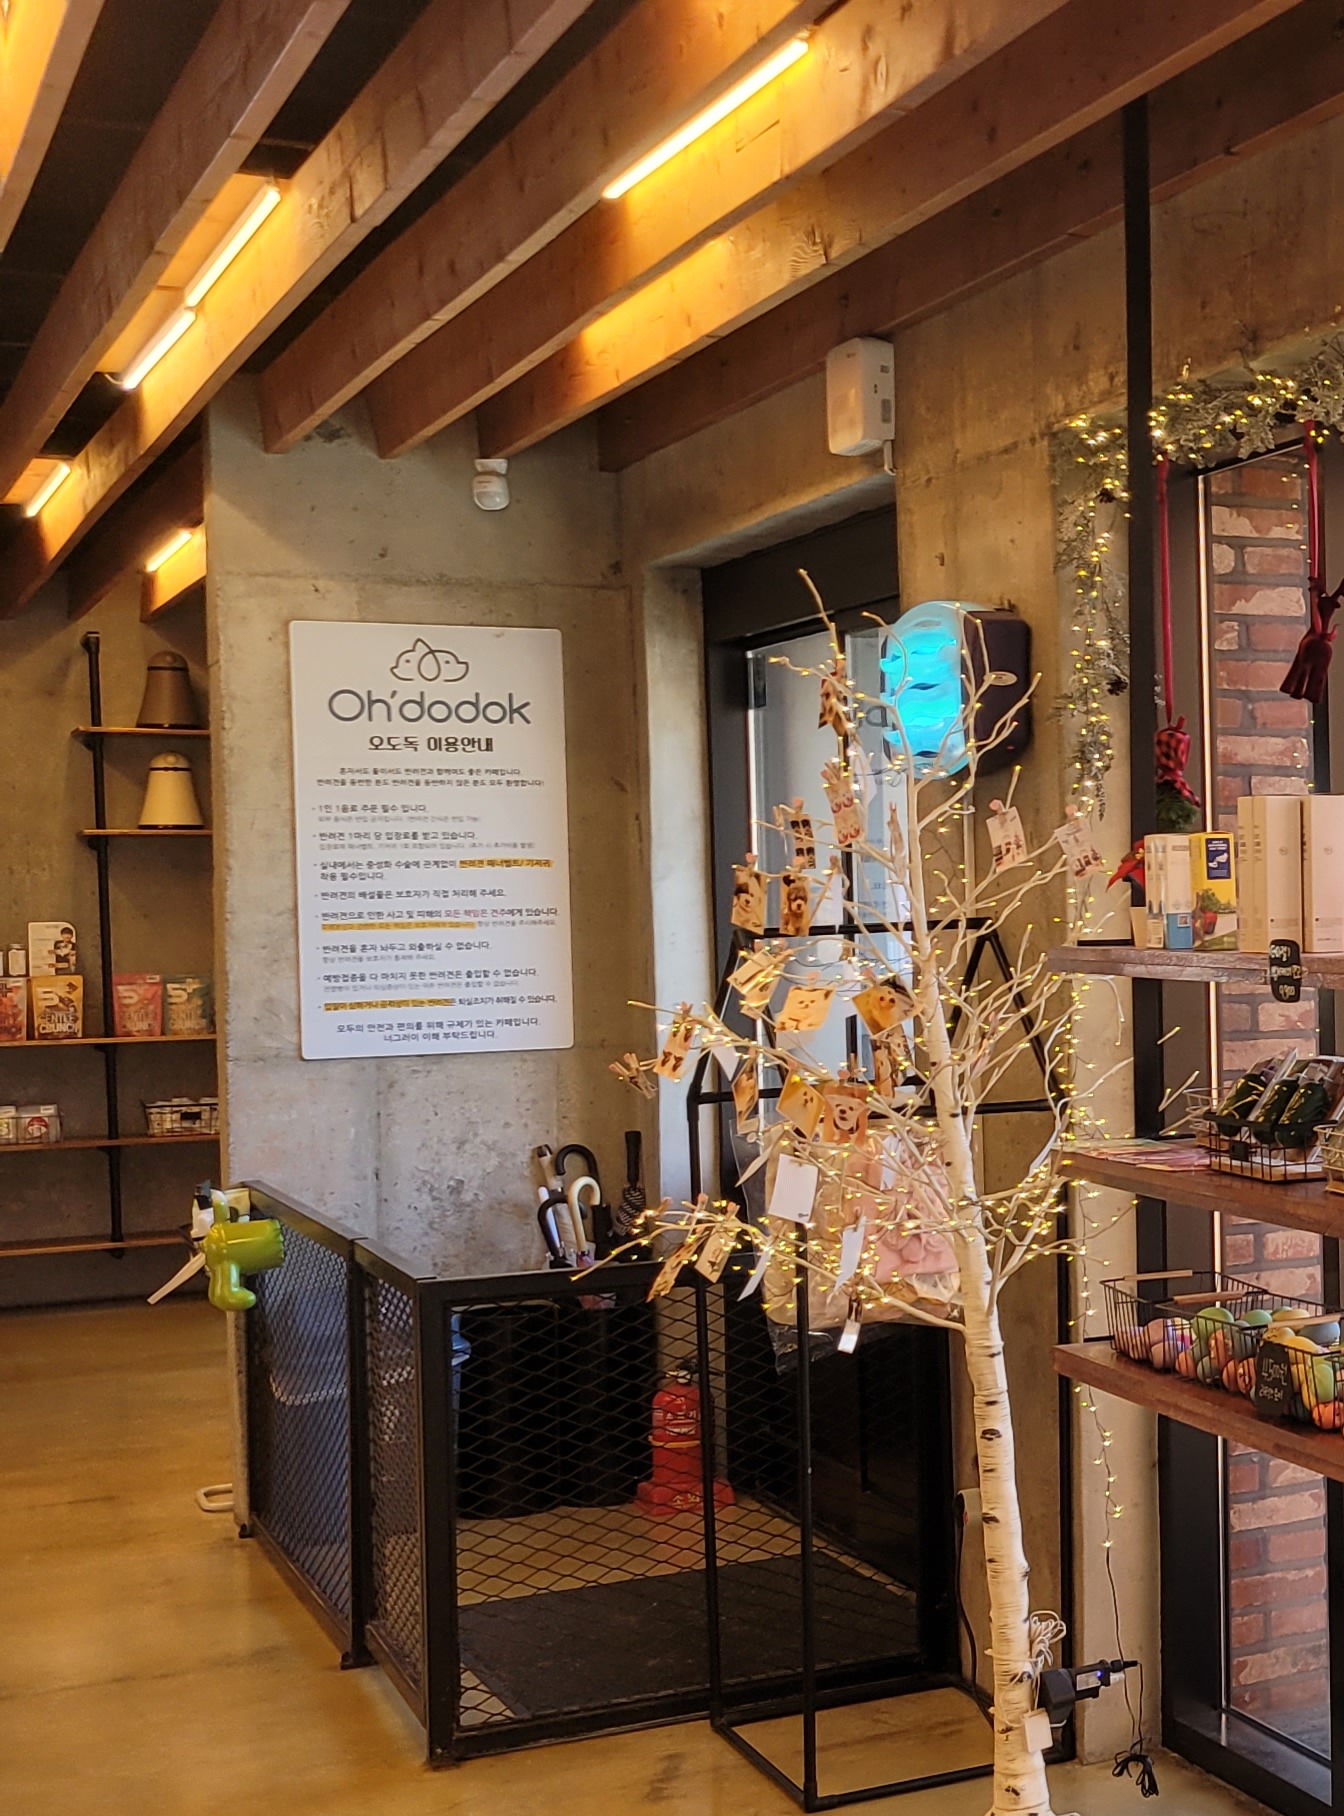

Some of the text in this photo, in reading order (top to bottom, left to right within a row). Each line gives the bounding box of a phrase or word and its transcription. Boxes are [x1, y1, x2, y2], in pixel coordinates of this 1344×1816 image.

[328, 688, 532, 725] Oh'dodok
[368, 734, 494, 753] 오도독 이용안내
